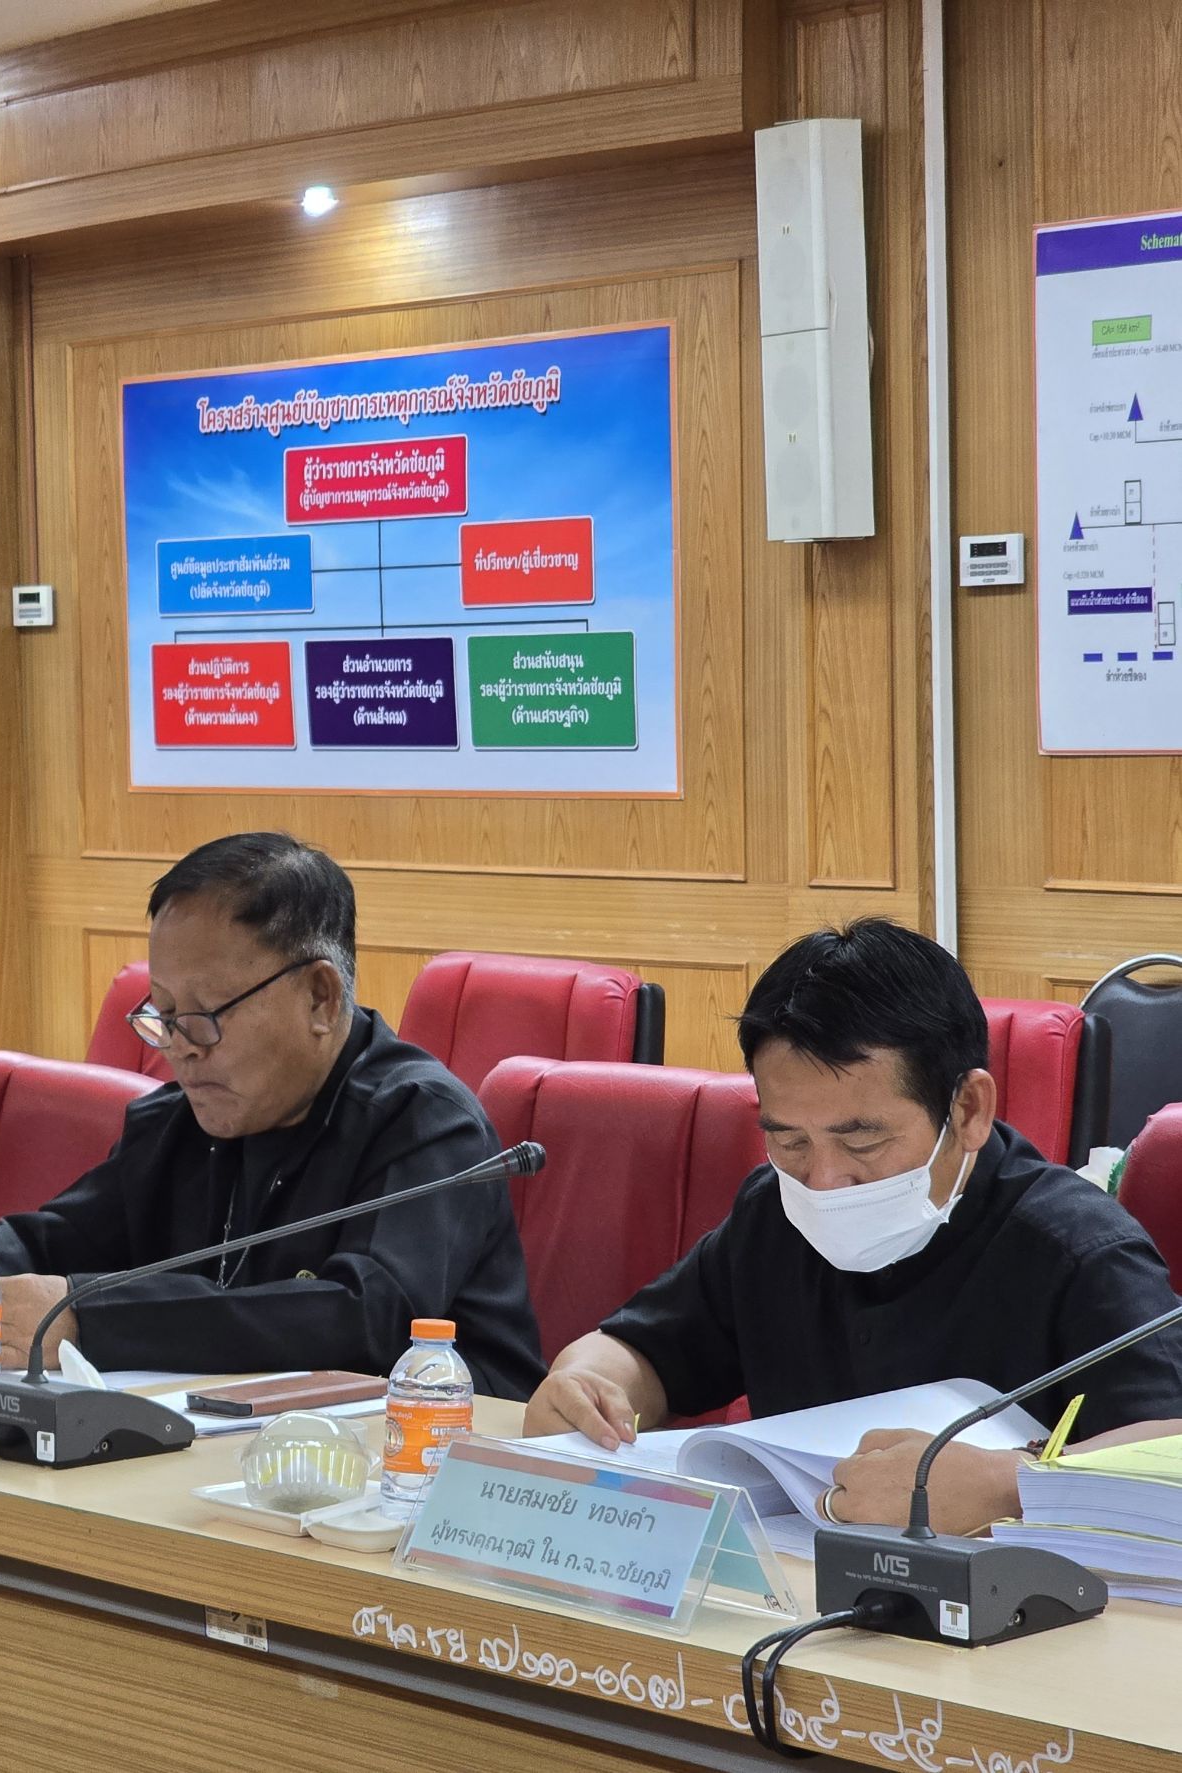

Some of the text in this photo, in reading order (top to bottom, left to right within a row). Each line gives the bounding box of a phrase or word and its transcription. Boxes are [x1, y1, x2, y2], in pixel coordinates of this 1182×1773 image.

[197, 365, 561, 435] โครงสร้างศูนย์บัญชาการเหตุการณ์จังหวัดชัยภูมิ
[304, 447, 445, 482] ผู้ว่าราชการจังหวัดชัยภูมิ
[299, 478, 449, 511] (ผู้บัญชาการเหตุการณ์จังหวัดชัยภูมิ)
[474, 546, 579, 574] ที่ปรึกษา/ผู้เชี่ยวชาญ
[342, 654, 413, 674] ส่วนอำนวยการ
[512, 651, 585, 674] ส่วนสนับสนุน
[162, 681, 280, 707] รองผู้ว่าราชการจังหวัดชัยภูมิ
[315, 678, 445, 707] รองผู้ว่าราชการจังหวัดชัยภูมิ
[480, 675, 622, 704] รองผู้ว่าราชการจังหวัดชัยภูมิ
[353, 708, 407, 727] (ด้านสังคม)
[511, 706, 590, 731] (ด้านเศรษฐกิจ)
[478, 1478, 656, 1534] นายสมชัย ทองคำ
[430, 1518, 672, 1593] ผู้ทรงคุณวุฒิ ใน ก.จ.จ.ชัยภูมิ
